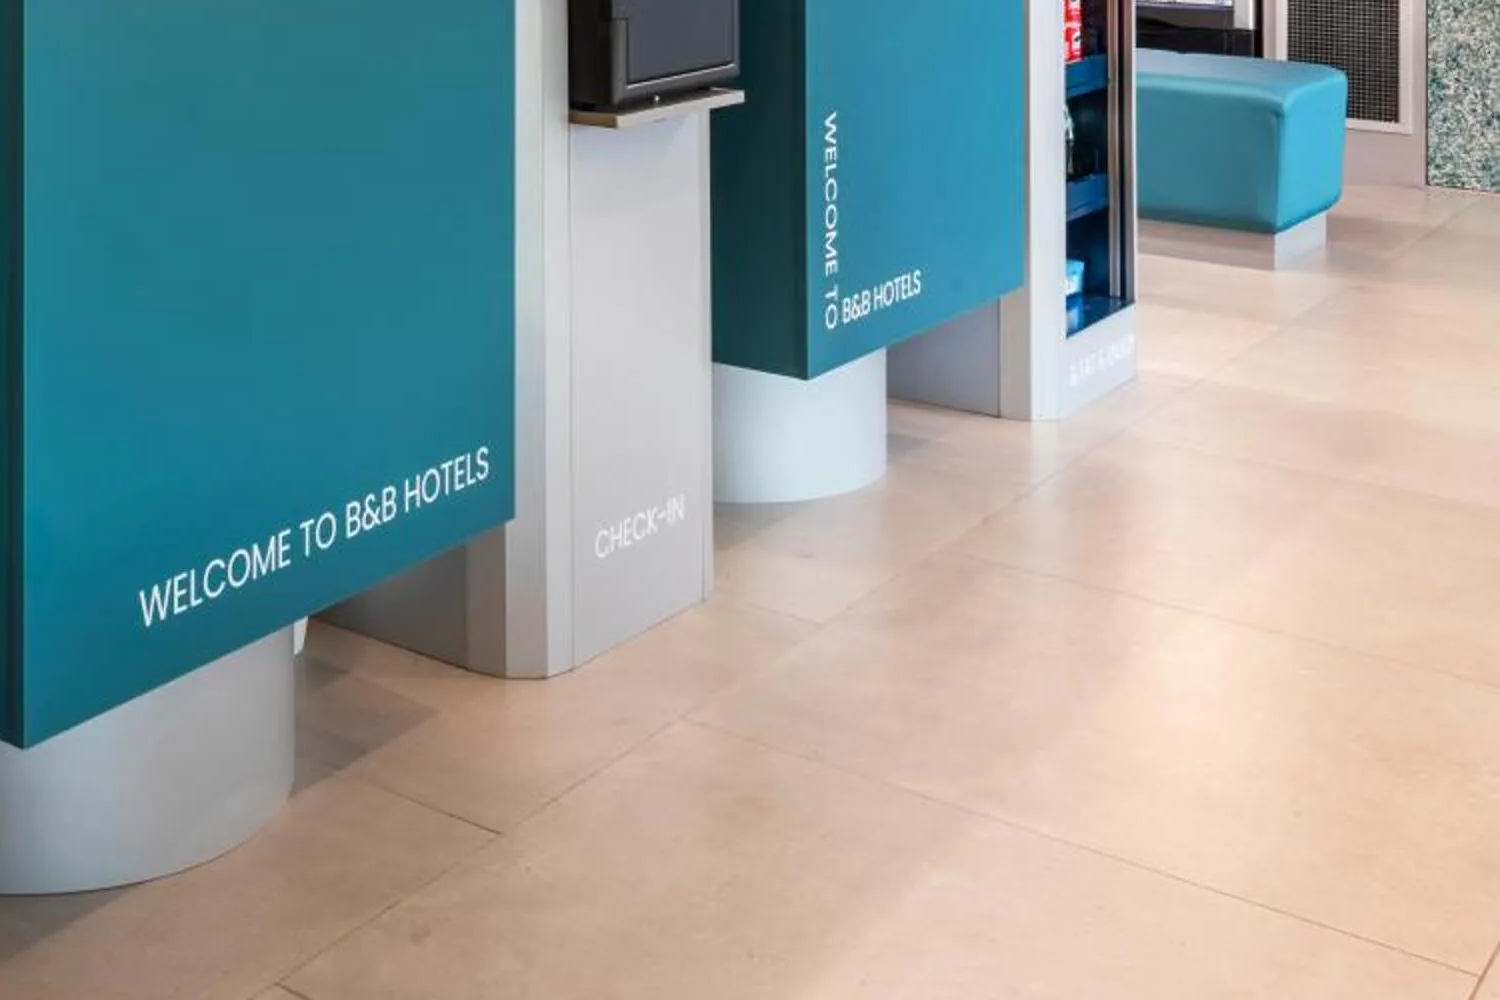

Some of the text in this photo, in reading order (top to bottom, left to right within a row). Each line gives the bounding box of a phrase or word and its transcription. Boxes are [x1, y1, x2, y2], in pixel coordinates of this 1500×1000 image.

[824, 112, 839, 329] WELCOME TO
[842, 269, 921, 324] B&B HOTELS
[139, 446, 490, 627] WELCOME TO B&B HOTELS
[595, 493, 686, 558] CHECK-IN
